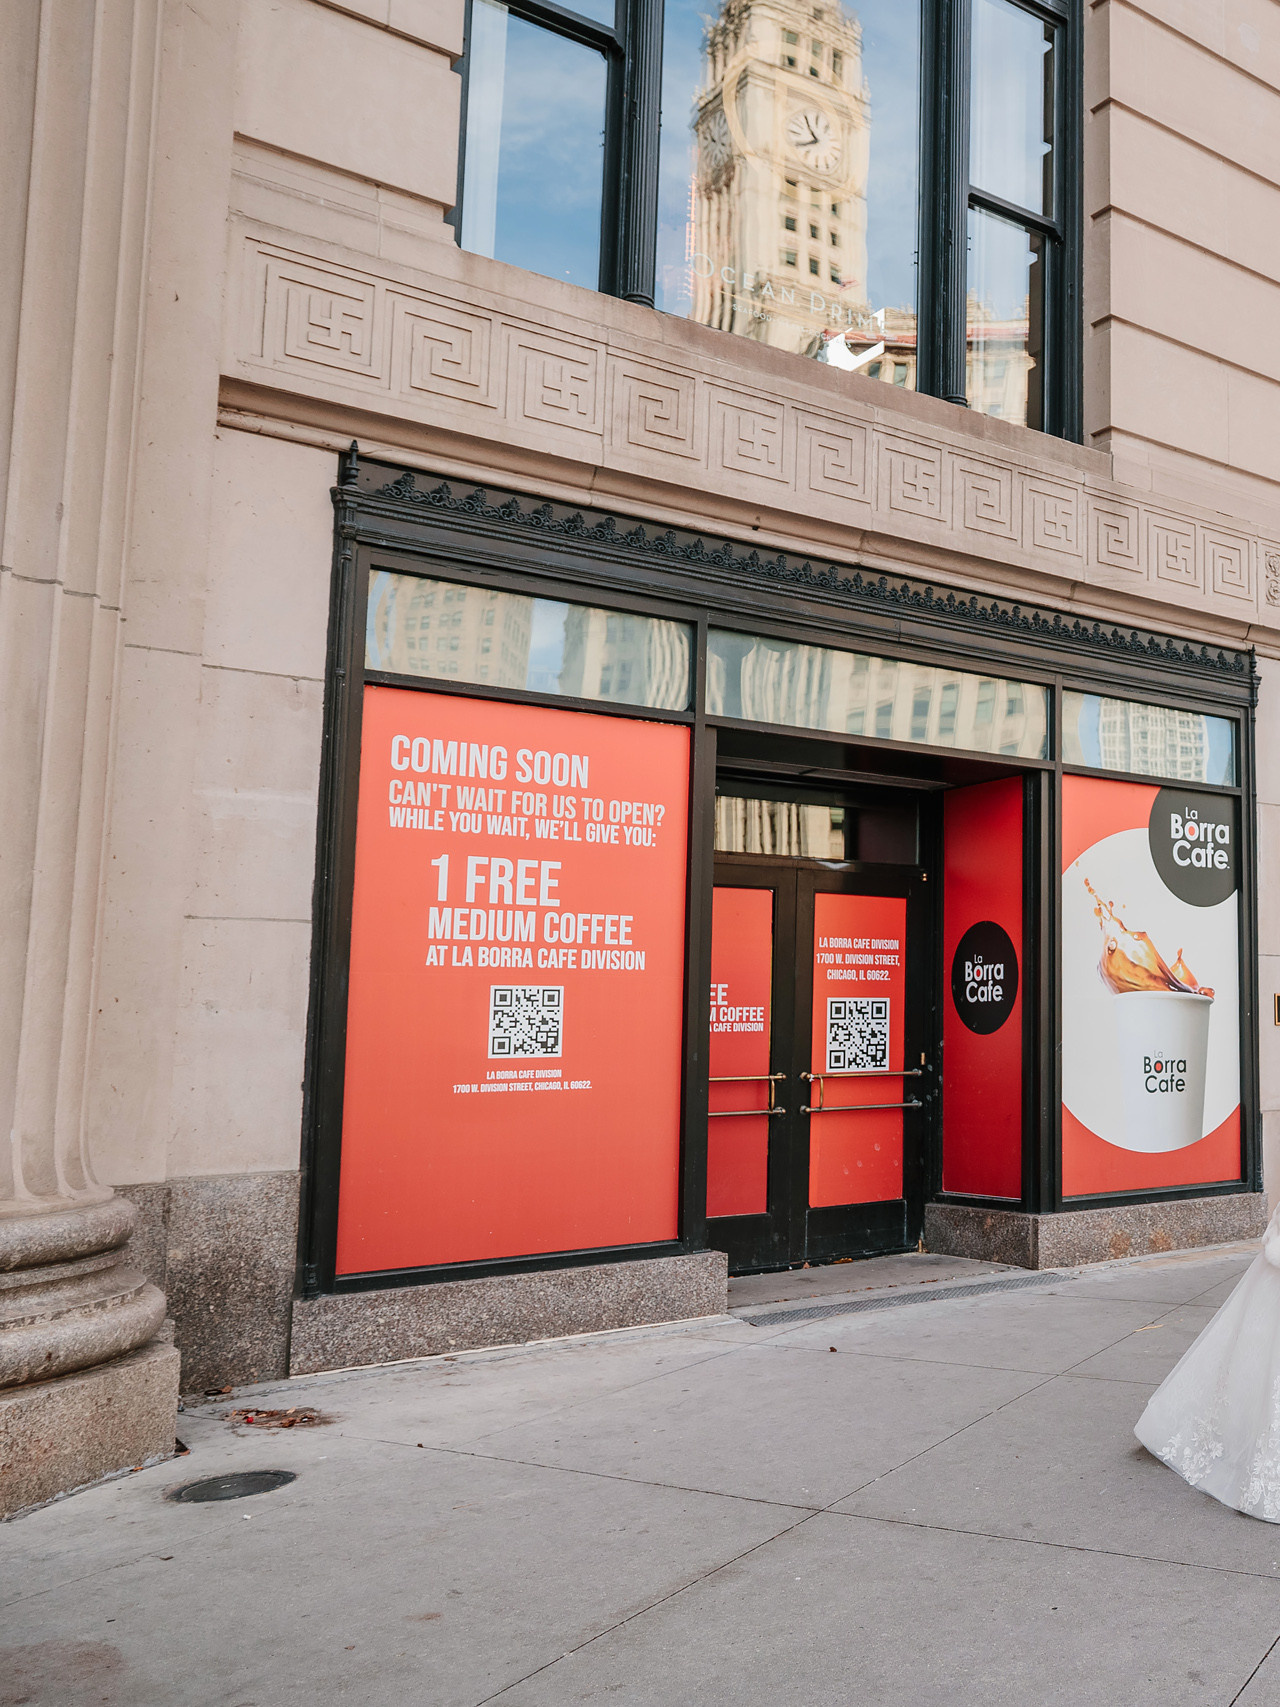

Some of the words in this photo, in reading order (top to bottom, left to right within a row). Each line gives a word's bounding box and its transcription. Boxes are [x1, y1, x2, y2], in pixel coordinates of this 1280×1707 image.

[690, 252, 795, 303] OCEAN
[810, 292, 888, 334] PRIME
[390, 734, 508, 781] COMING
[515, 748, 589, 789] SOON
[389, 779, 451, 808] CAN'T
[456, 785, 506, 813] WAIT
[511, 791, 547, 816] FOR
[552, 794, 576, 819] US
[581, 797, 603, 821] TO
[609, 800, 665, 826] OPEN?
[1185, 806, 1198, 820] La
[389, 806, 445, 831] WHILE
[449, 811, 482, 834] YOU
[486, 814, 530, 840] WAIT,
[535, 818, 581, 841] WE’LL
[586, 823, 619, 845] GIVE
[623, 826, 657, 847] YOU:
[1171, 813, 1230, 844] Borra
[431, 854, 449, 902] 1
[465, 855, 562, 907] FREE
[427, 907, 536, 942] MEDIUM
[543, 911, 633, 945] COFFEE
[819, 937, 828, 948] LA
[829, 937, 852, 949] BORRA
[853, 938, 870, 950] CAFE
[871, 939, 899, 950] DIVISION
[425, 945, 448, 966] AT
[452, 946, 473, 967] LA
[478, 947, 533, 968] BORRA
[537, 948, 577, 969] CAFE
[581, 949, 645, 970] DIVISION
[816, 953, 834, 964] 1700
[845, 953, 873, 965] DIVISION
[875, 954, 900, 967] STREET,
[974, 954, 983, 964] La
[827, 969, 858, 981] CHICAGO,
[859, 969, 866, 980] IL
[867, 969, 890, 980] 60622.
[965, 961, 1004, 981] Borra
[710, 983, 728, 1005] EE
[719, 1006, 764, 1021] COFFEE
[713, 1022, 732, 1032] CAFE
[733, 1022, 764, 1032] DIVISION
[486, 1071, 495, 1080] LA
[496, 1070, 517, 1080] BORRA
[518, 1070, 535, 1079] CAFE
[535, 1069, 562, 1078] DIVISION
[1143, 1056, 1187, 1074] Borra
[452, 1084, 471, 1094] 1700
[480, 1083, 508, 1092] DIVISION
[1145, 1074, 1185, 1093] Cafe
